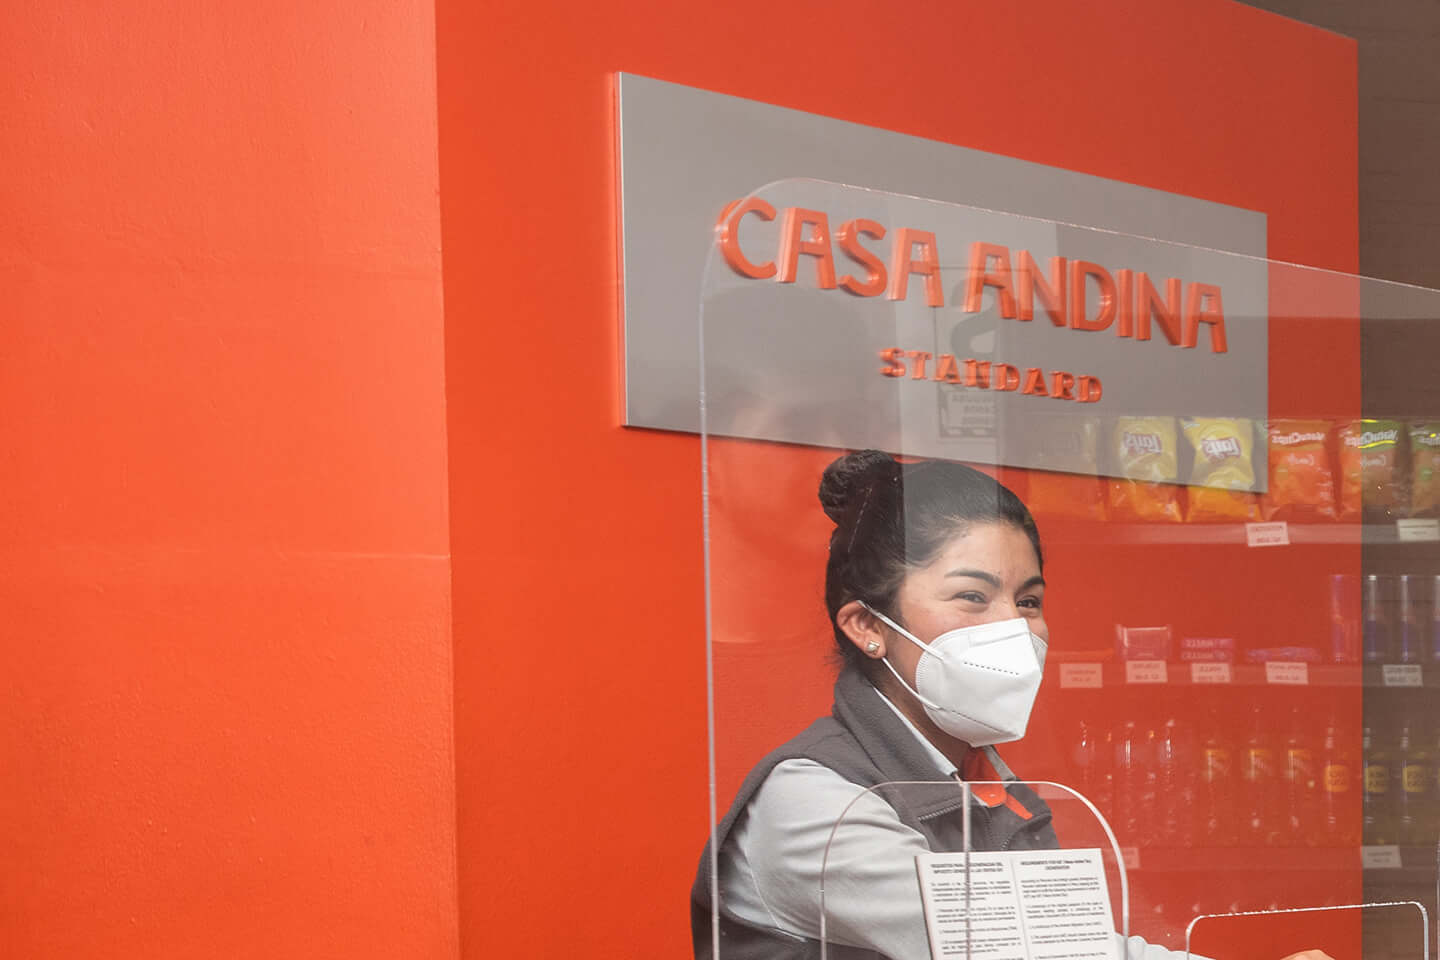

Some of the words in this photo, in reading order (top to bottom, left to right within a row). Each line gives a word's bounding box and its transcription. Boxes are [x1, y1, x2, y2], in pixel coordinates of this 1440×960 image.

[715, 196, 944, 308] CASA
[962, 242, 1228, 354] ANDINA
[878, 347, 1104, 404] STANDARD
